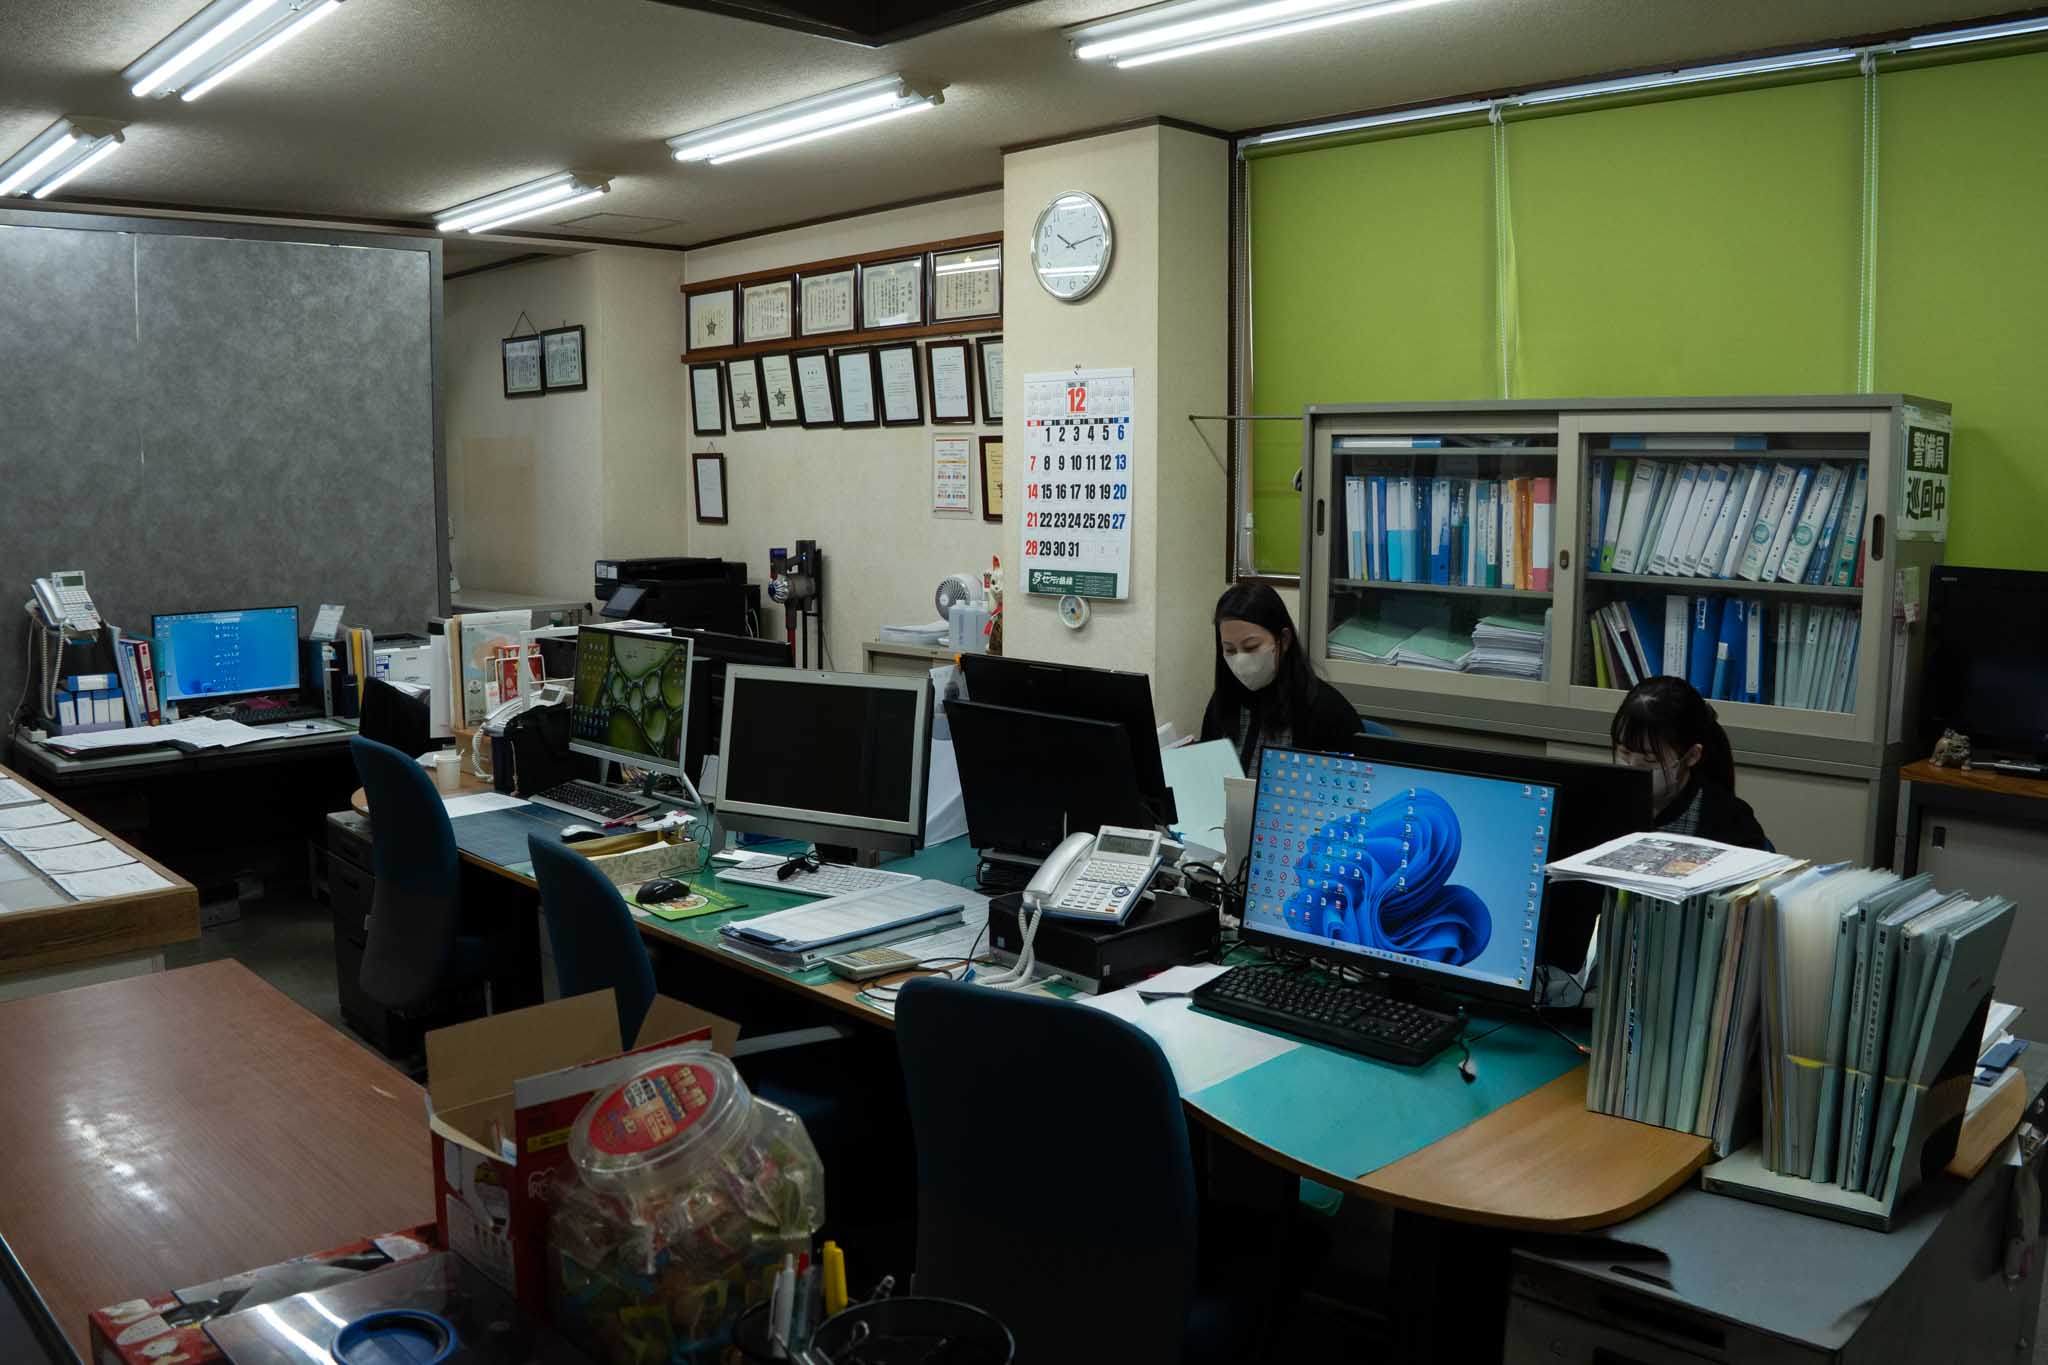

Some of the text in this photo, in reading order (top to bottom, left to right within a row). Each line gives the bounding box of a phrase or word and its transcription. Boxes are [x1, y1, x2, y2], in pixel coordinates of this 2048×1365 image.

[1067, 387, 1086, 412] 12
[1045, 424, 1124, 442] 1 2 3 4 5 6
[1912, 430, 1945, 469] 警備員
[1030, 454, 1126, 471] 7 8 9 10 11 12 13
[1027, 484, 1127, 500] 14 15 16 17 18 19 20
[1906, 476, 1946, 521] 巡回中
[1027, 512, 1126, 529] 21 22 23 24 25 26 27
[1025, 540, 1080, 557] 28 29 30 31
